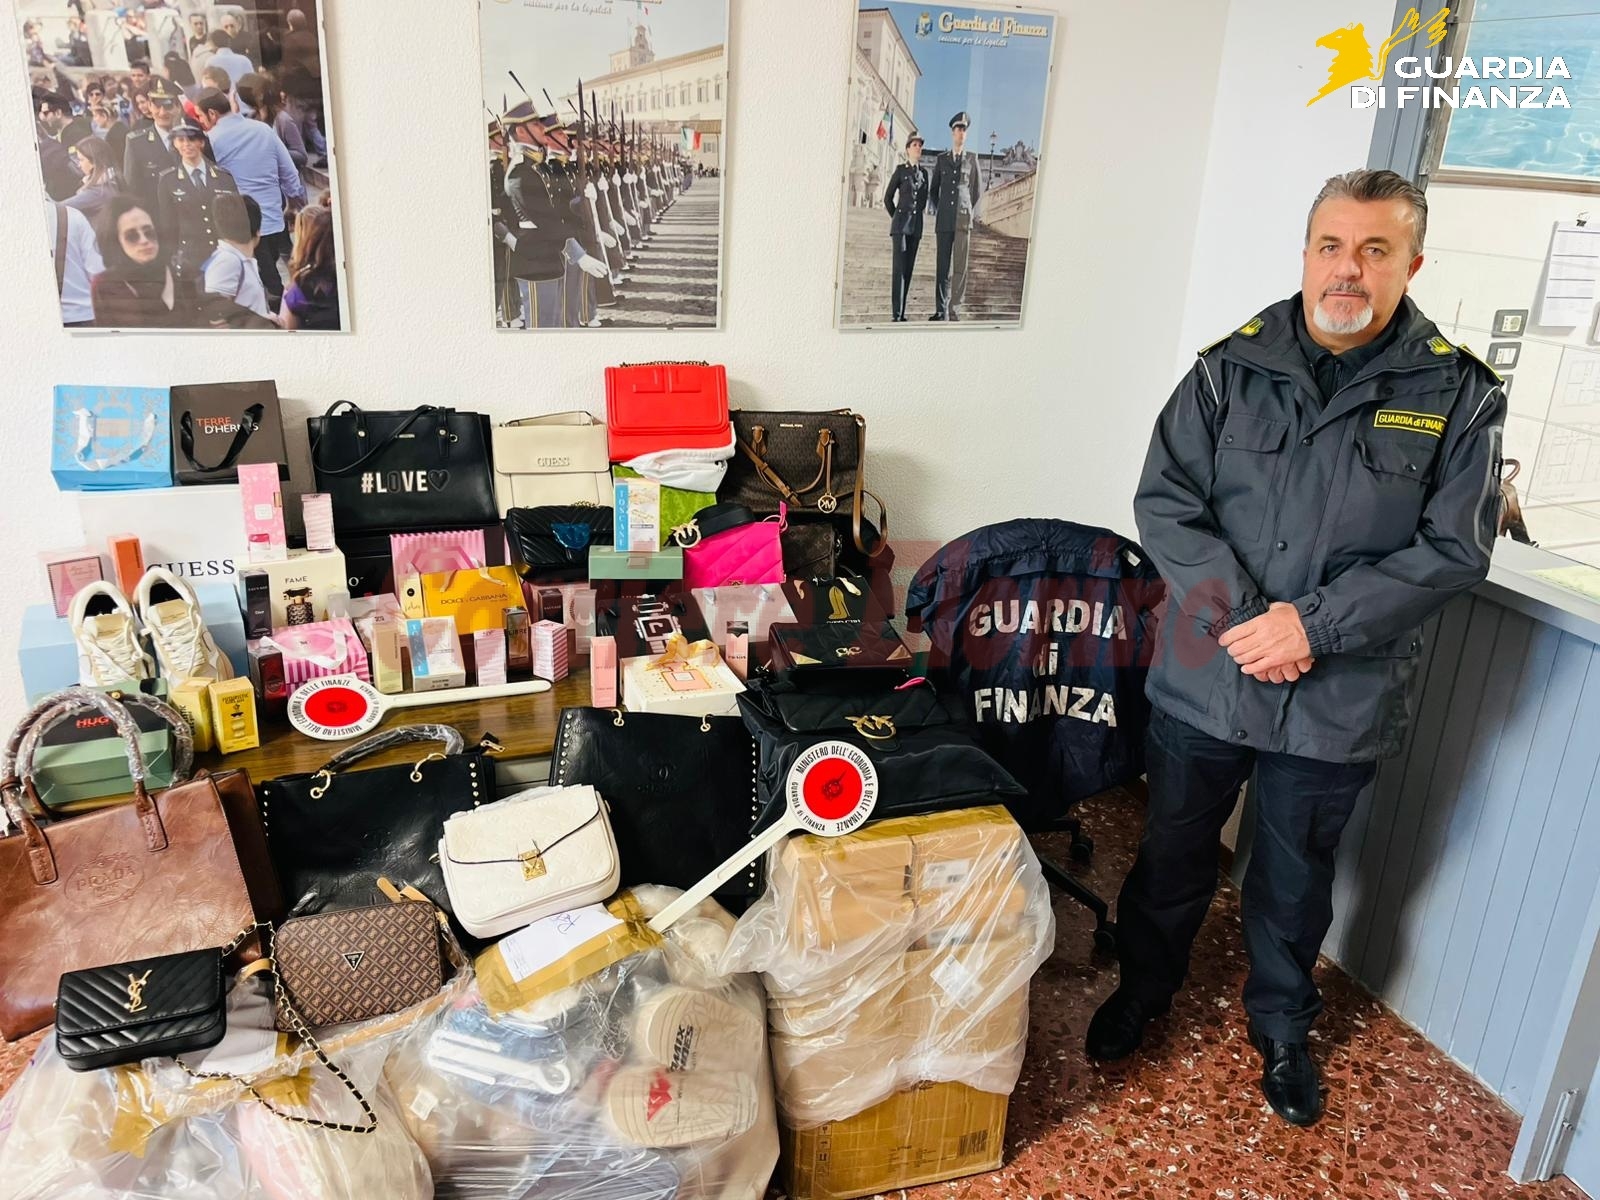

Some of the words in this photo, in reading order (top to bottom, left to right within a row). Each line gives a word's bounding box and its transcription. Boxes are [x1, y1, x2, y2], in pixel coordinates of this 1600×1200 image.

[939, 12, 988, 33] Guardia
[989, 17, 1000, 33] di
[1002, 15, 1048, 38] Finanza
[196, 417, 231, 428] TERRE
[1379, 414, 1413, 427] GUARDIA
[1414, 418, 1421, 427] di
[536, 457, 570, 467] GUESS
[285, 576, 308, 584] FAME
[968, 599, 1128, 640] GUARDIA
[1033, 642, 1058, 678] di
[299, 683, 320, 696] DELLE
[320, 679, 351, 687] FINANZE
[292, 700, 306, 725] ECONOMIA
[974, 684, 1118, 728] FINANZA
[322, 725, 362, 736] MINISTERO
[796, 746, 829, 774] MINISTERO
[848, 750, 873, 781] ECONOMIA
[791, 781, 801, 808] GUARDIA
[803, 815, 826, 831] FINANZA
[860, 790, 873, 812] DELLE
[836, 811, 864, 832] FINANZE
